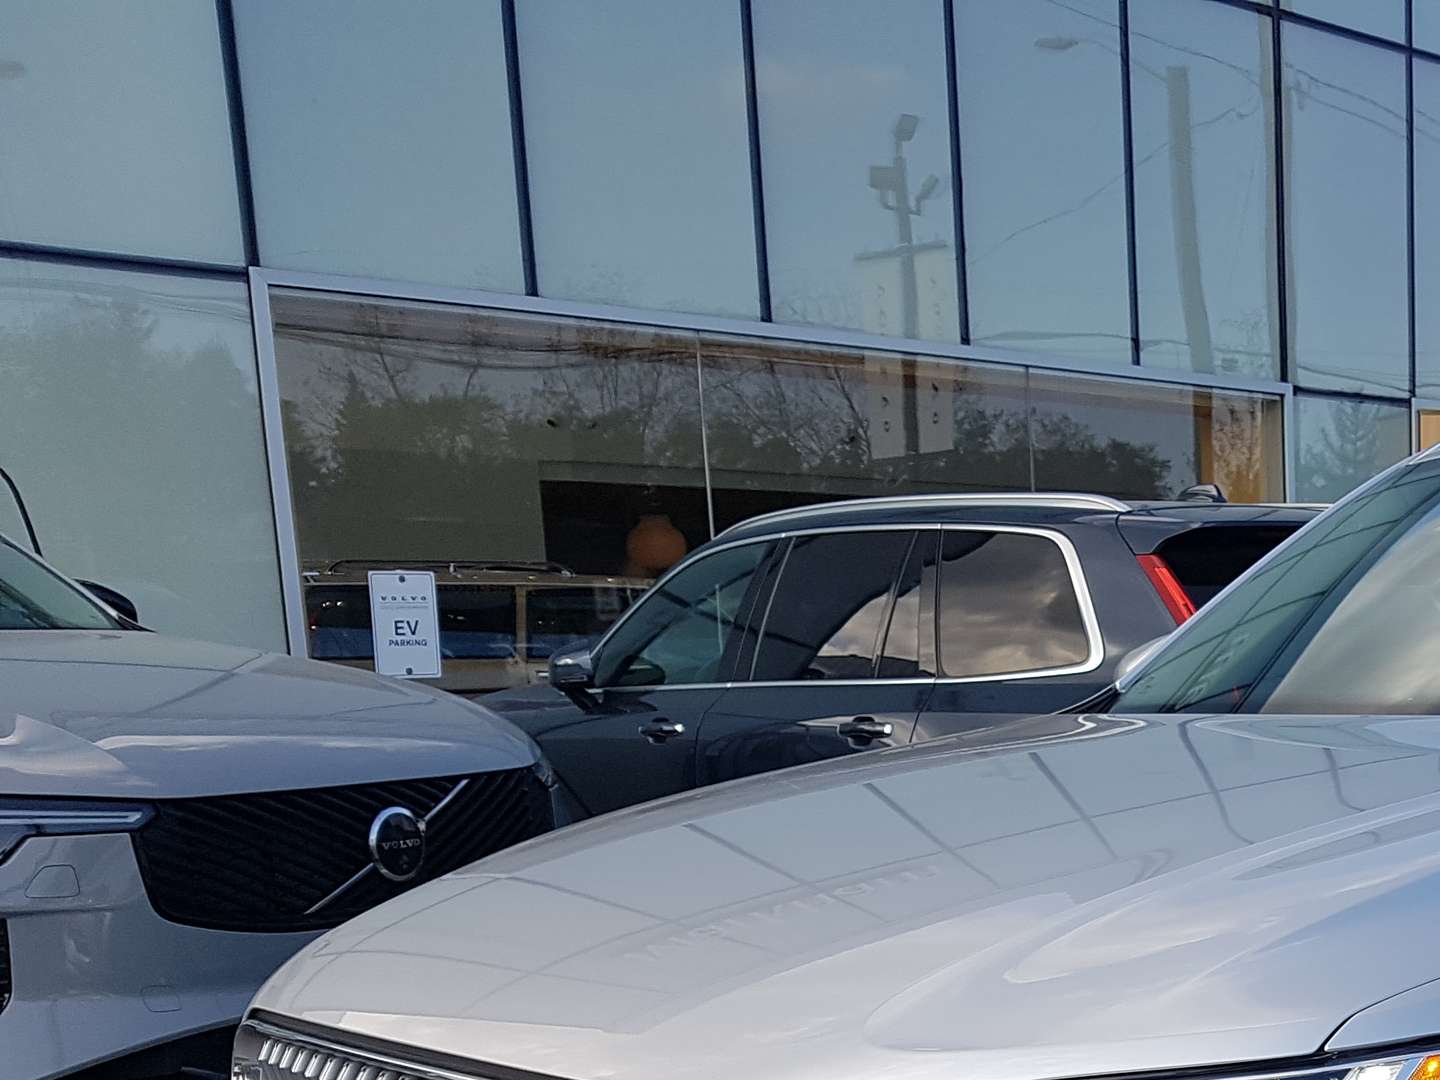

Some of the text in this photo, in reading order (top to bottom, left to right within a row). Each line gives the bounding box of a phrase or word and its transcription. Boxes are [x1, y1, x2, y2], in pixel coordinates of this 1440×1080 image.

[393, 620, 419, 636] EV
[388, 639, 428, 647] PARKING
[382, 838, 421, 851] VOLVO
